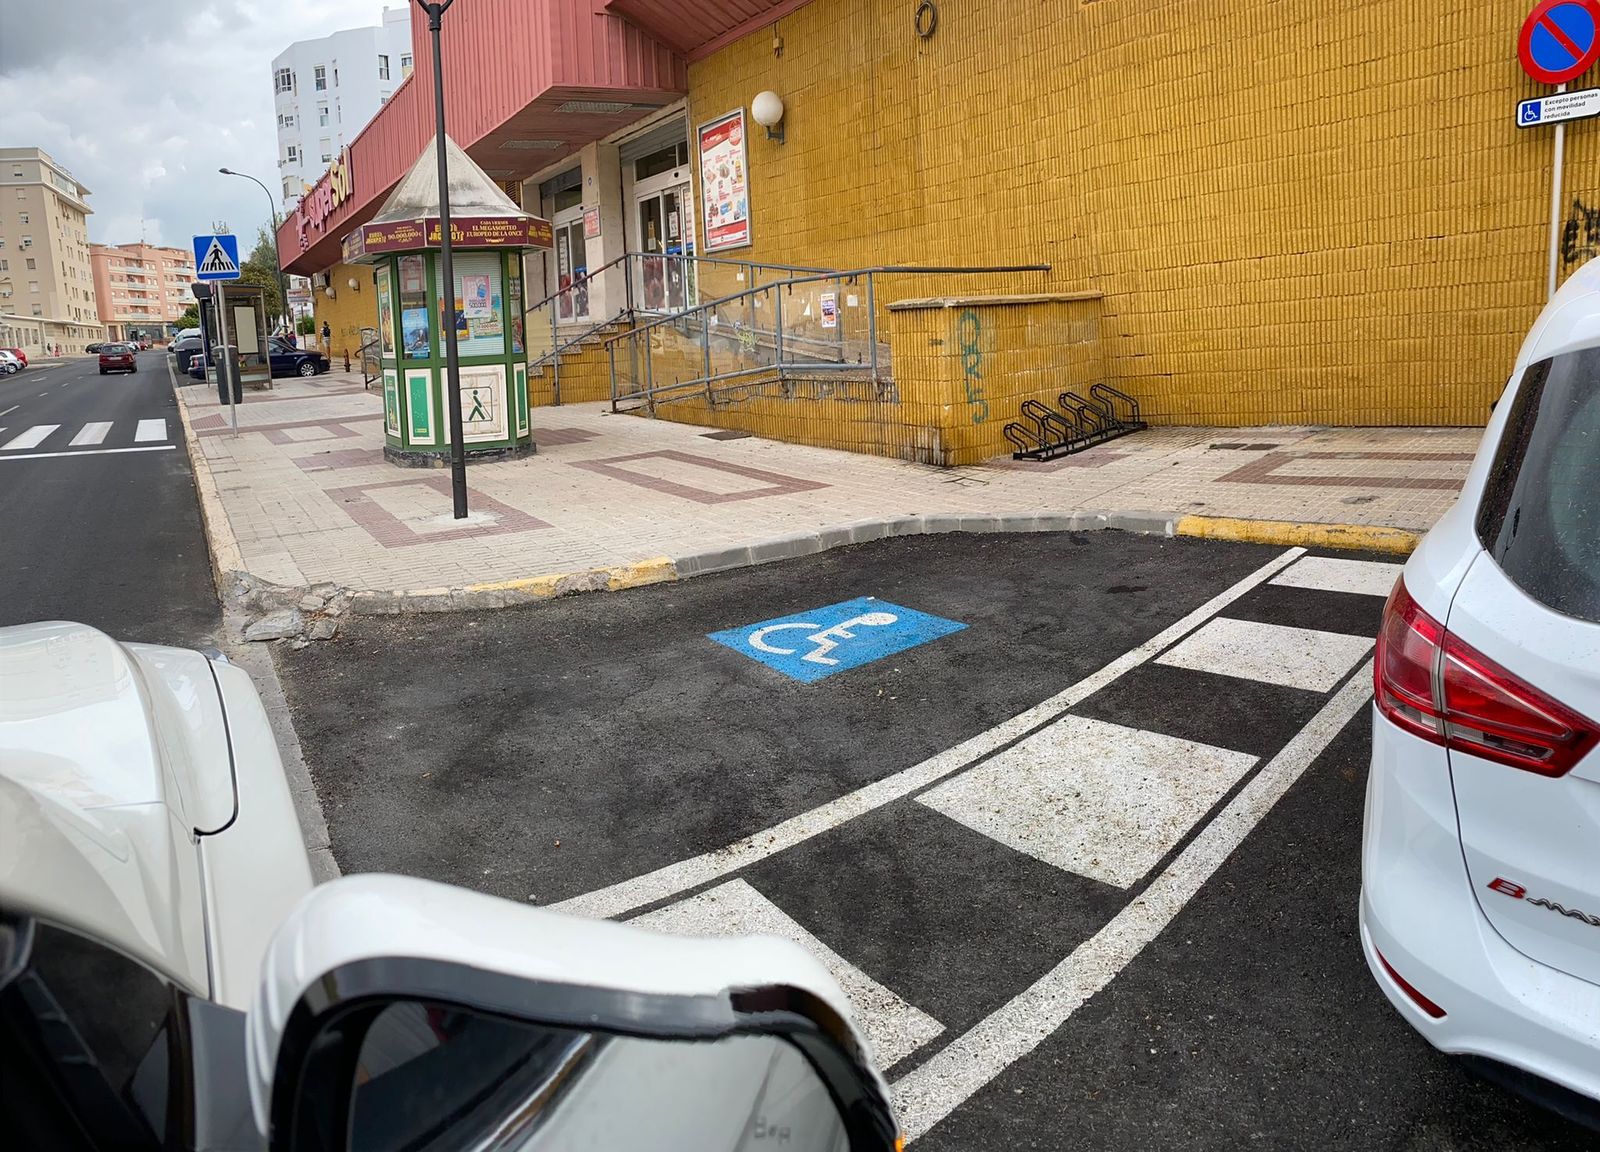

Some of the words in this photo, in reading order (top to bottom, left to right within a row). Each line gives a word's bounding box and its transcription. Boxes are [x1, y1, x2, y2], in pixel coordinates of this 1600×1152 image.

[1545, 97, 1569, 105] Excepto
[1570, 93, 1598, 101] personas
[1557, 101, 1586, 110] movilidad
[1544, 111, 1571, 119] reducida
